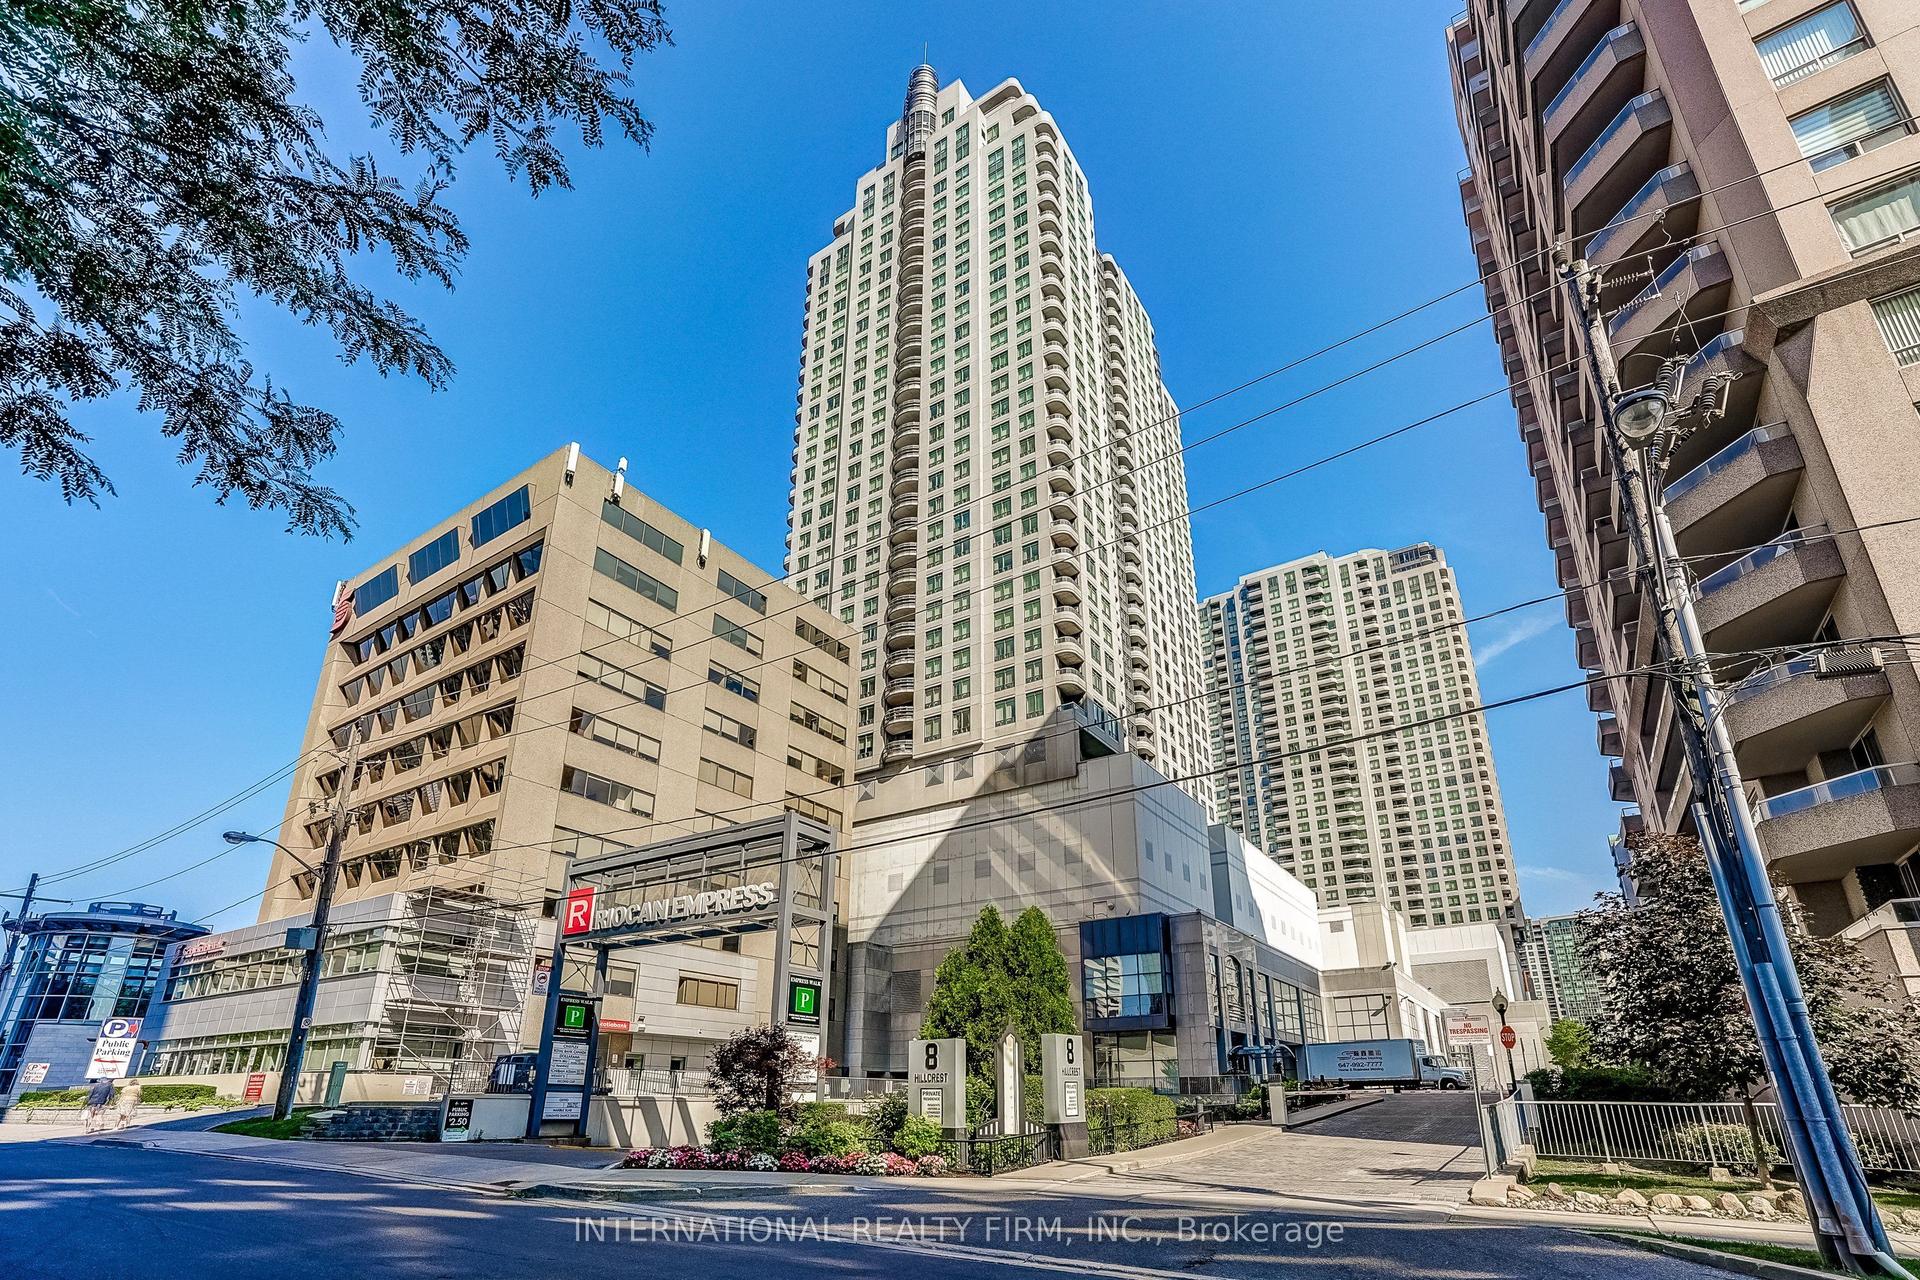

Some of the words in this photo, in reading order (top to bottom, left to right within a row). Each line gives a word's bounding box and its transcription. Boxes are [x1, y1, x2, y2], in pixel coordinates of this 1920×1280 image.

[595, 899, 669, 929] RIOCAN
[673, 882, 775, 918] EMPRESS
[568, 900, 589, 929] R
[801, 992, 810, 1008] P
[570, 1010, 580, 1023] P
[108, 1022, 127, 1035] P
[1501, 1032, 1515, 1042] STOP
[102, 1040, 130, 1048] Public
[95, 1048, 131, 1057] Parking
[925, 1043, 938, 1070] 8
[1066, 1038, 1074, 1065] 8
[914, 1073, 948, 1083] HILLCREST
[449, 1117, 467, 1126] $2.50
